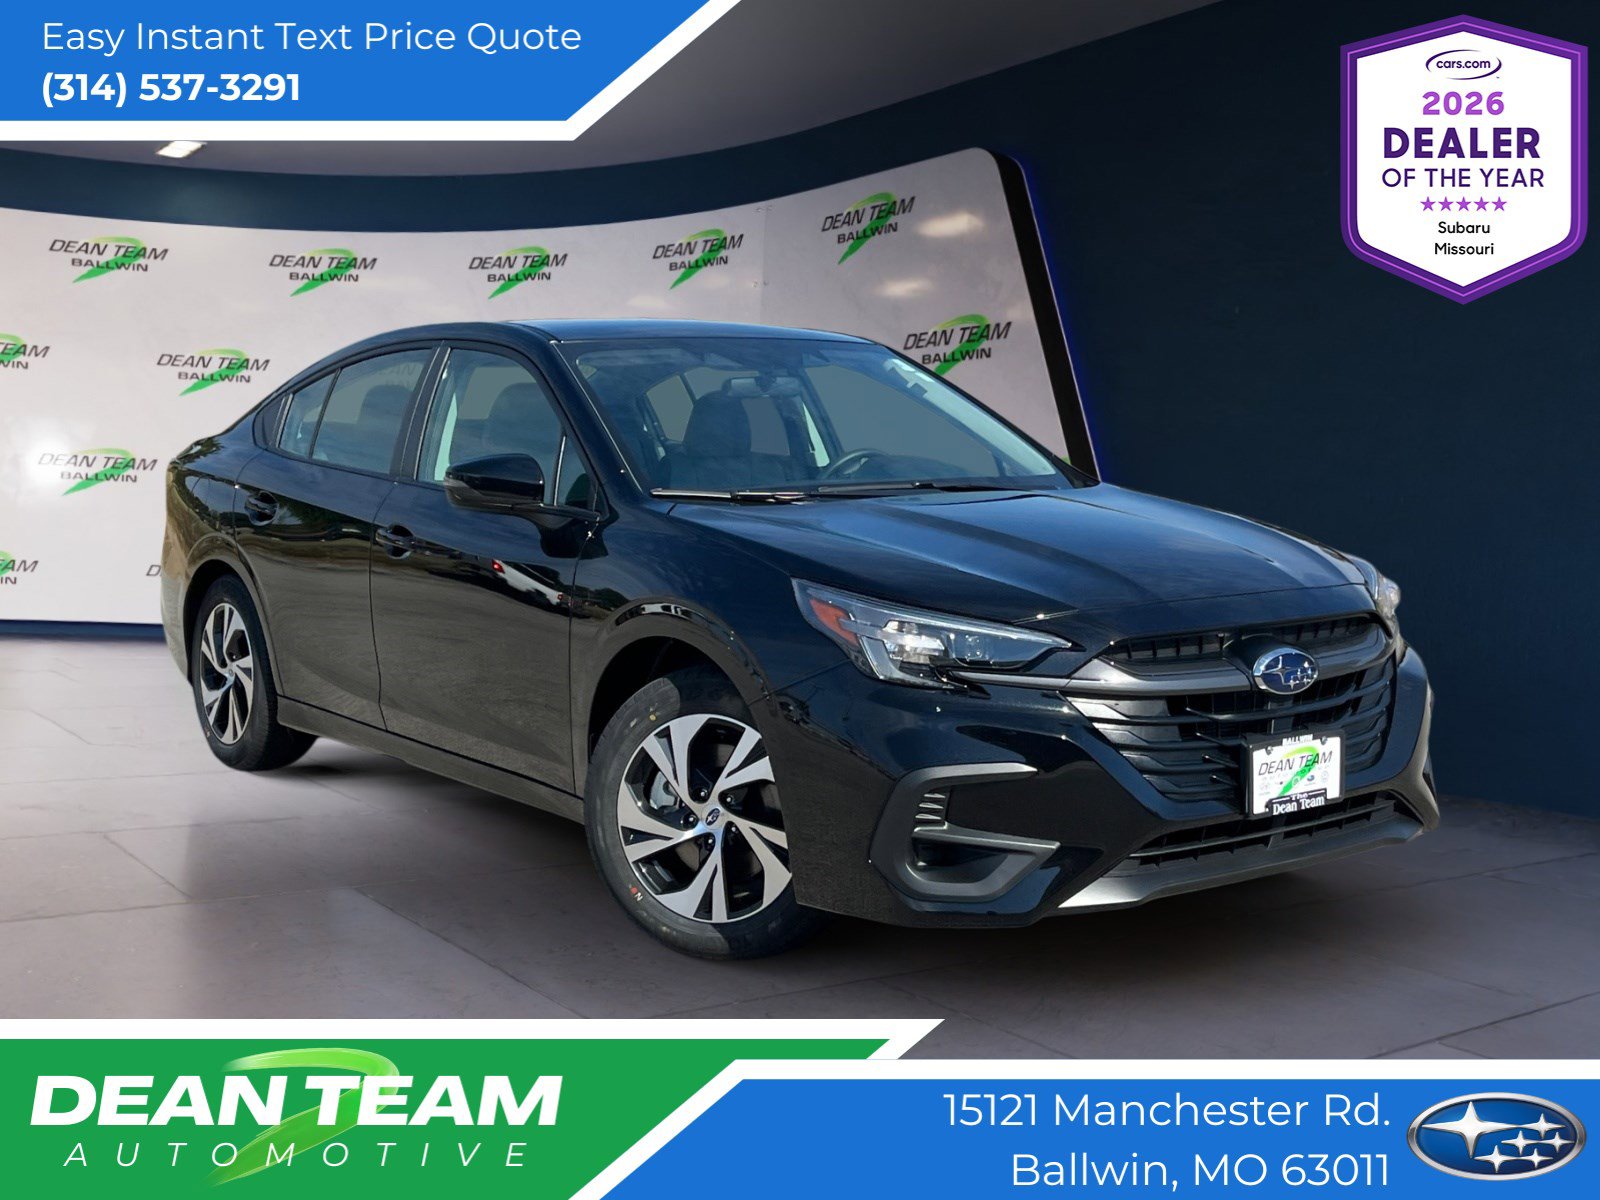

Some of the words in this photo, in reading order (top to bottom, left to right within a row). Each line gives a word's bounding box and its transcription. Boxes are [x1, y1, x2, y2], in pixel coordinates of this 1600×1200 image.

[821, 208, 865, 232] DEAN
[870, 196, 916, 221] TEAM
[837, 222, 898, 244] BALLWIN
[49, 239, 108, 255] DEAN
[114, 245, 168, 260] TEAM
[652, 241, 698, 259] DEAN
[702, 234, 744, 253] TEAM
[71, 258, 148, 272] BALLWIN
[268, 254, 322, 269] DEAN
[327, 256, 377, 270] TEAM
[468, 255, 517, 270] DEAN
[522, 253, 568, 268] TEAM
[669, 256, 728, 271] BALLWIN
[289, 272, 359, 282] BALLWIN
[487, 271, 551, 282] BALLWIN
[903, 329, 953, 350] DEAN
[959, 321, 1012, 344] TEAM
[156, 353, 212, 369] DEAN
[218, 356, 270, 371] TEAM
[922, 347, 992, 364] BALLWIN
[178, 371, 251, 383] BALLWIN
[38, 453, 97, 468] DEAN
[103, 456, 158, 471] TEAM
[61, 471, 137, 483] BALLWIN
[1258, 759, 1295, 776] DEAN
[1299, 750, 1333, 768] TEAM
[1272, 802, 1298, 816] Dean
[1300, 796, 1325, 810] Team
